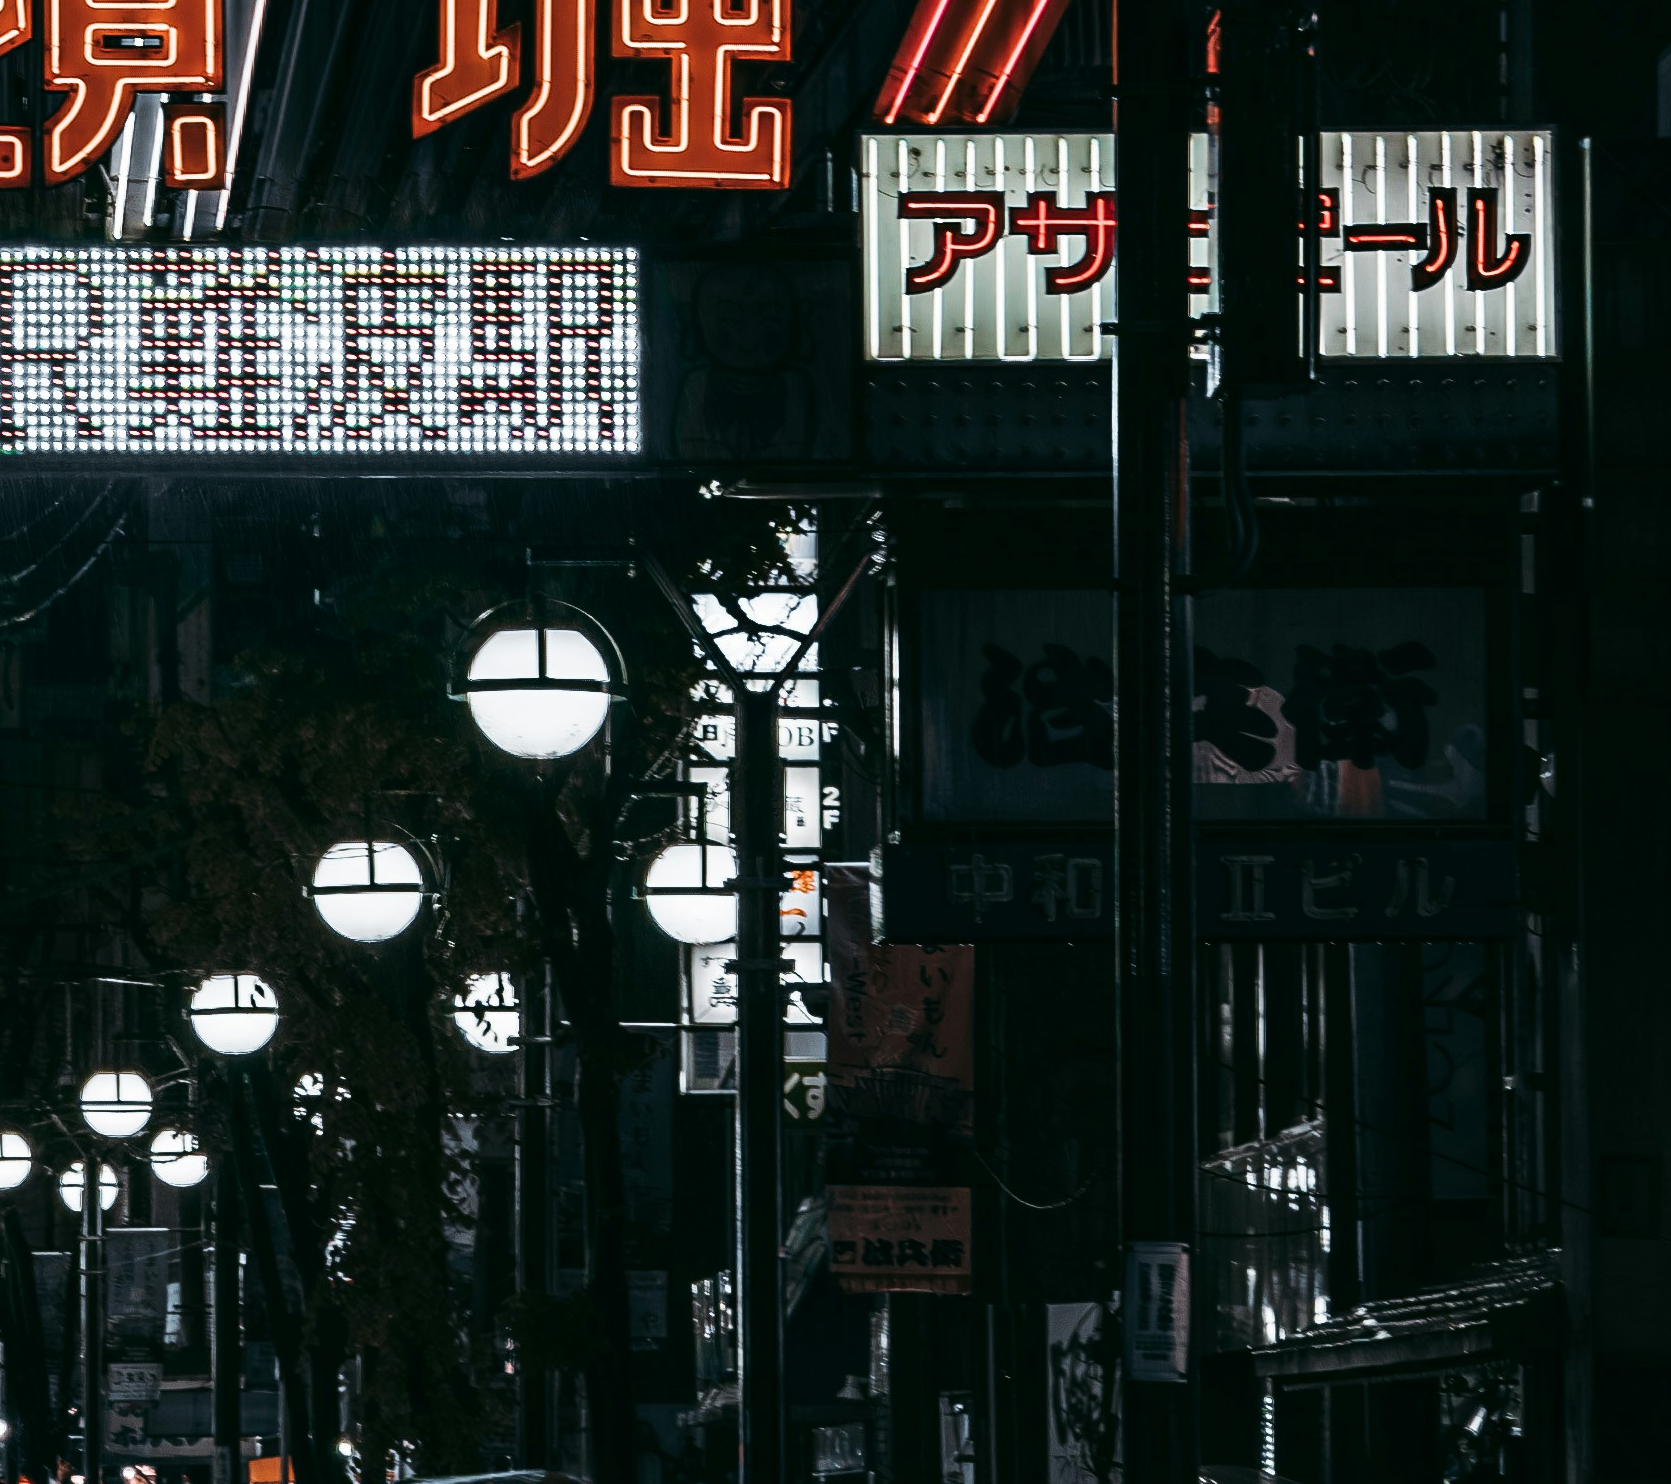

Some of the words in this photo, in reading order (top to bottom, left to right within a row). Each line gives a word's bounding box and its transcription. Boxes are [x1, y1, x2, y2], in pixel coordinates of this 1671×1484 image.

[898, 187, 1531, 295] アサール
[822, 786, 840, 830] 2F
